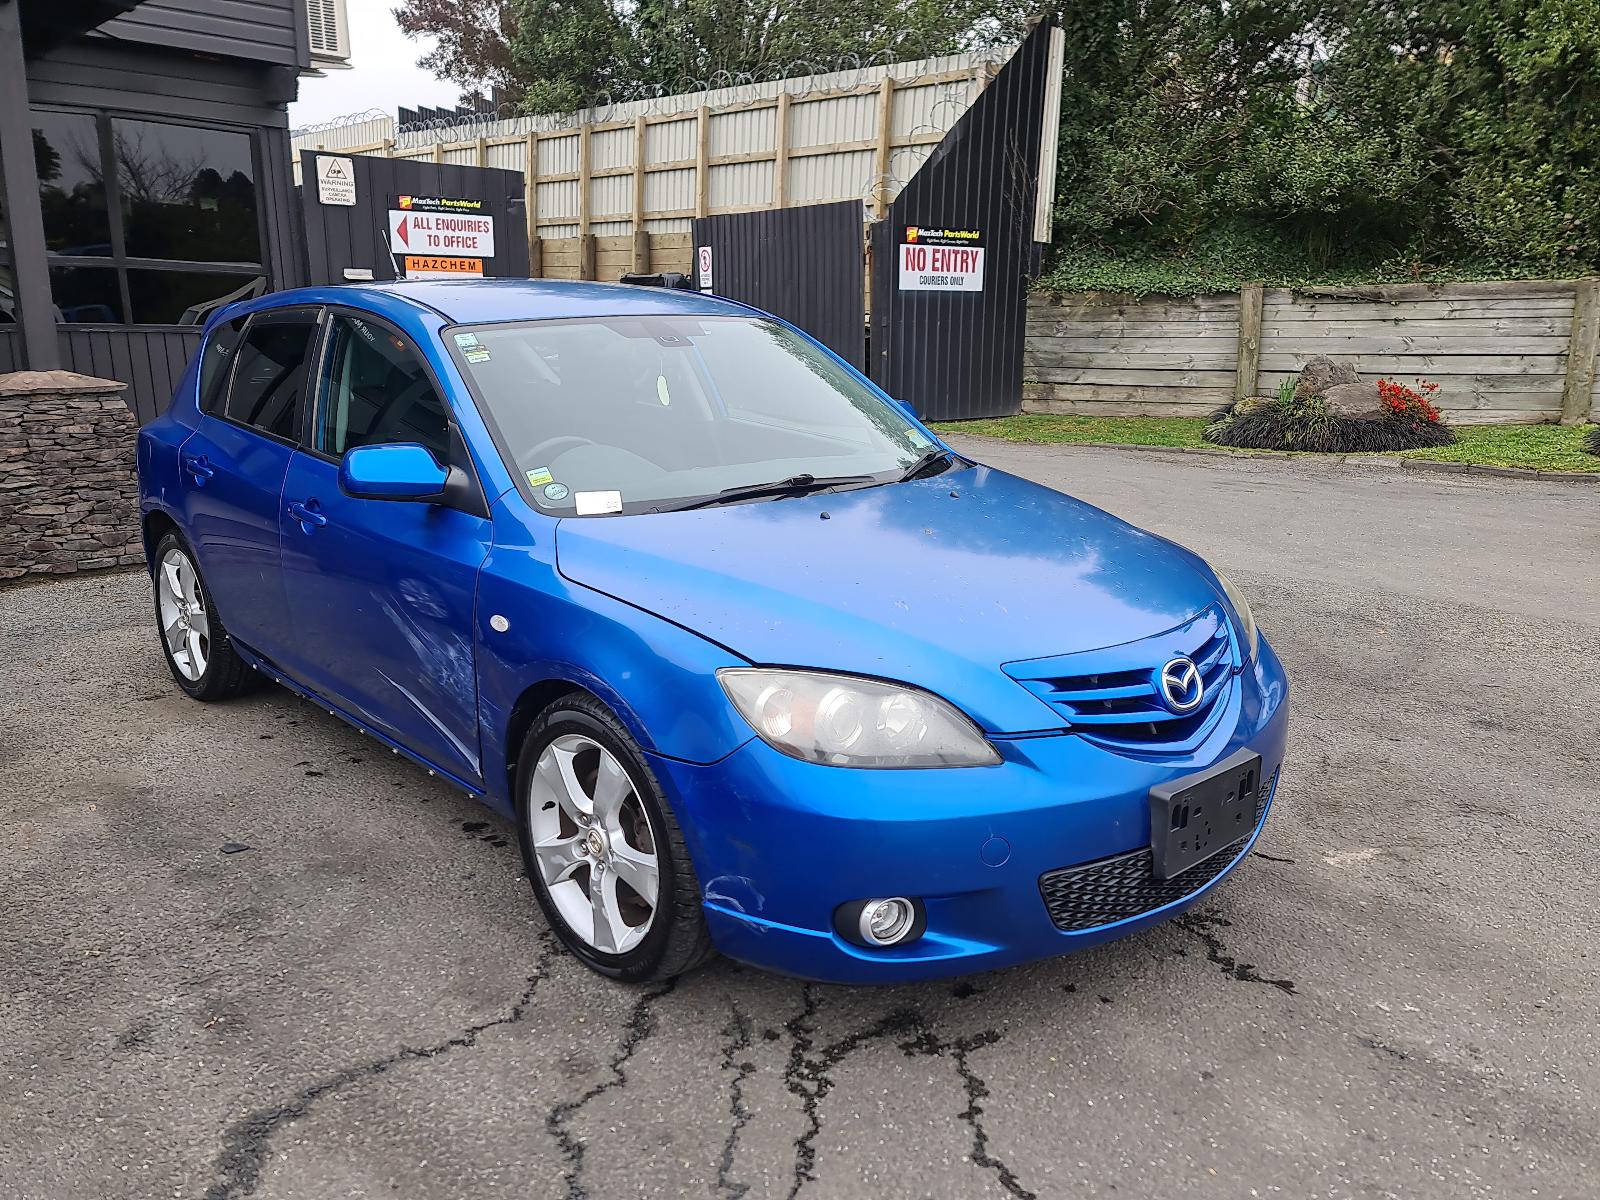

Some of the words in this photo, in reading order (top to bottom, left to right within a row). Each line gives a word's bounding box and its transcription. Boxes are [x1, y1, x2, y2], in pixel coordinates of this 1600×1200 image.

[320, 179, 354, 187] WARNING
[441, 198, 481, 208] PartsWorld
[413, 217, 432, 230] ALL
[435, 217, 490, 233] ENQUIRIES
[943, 229, 980, 239] PartsWorld
[427, 234, 440, 247] TO
[443, 235, 478, 249] OFFICE
[412, 259, 476, 271] HAZCHEM
[905, 247, 926, 272] NO
[932, 248, 979, 273] ENTRY
[919, 275, 949, 286] COURIERS
[949, 276, 965, 286] ONLY
